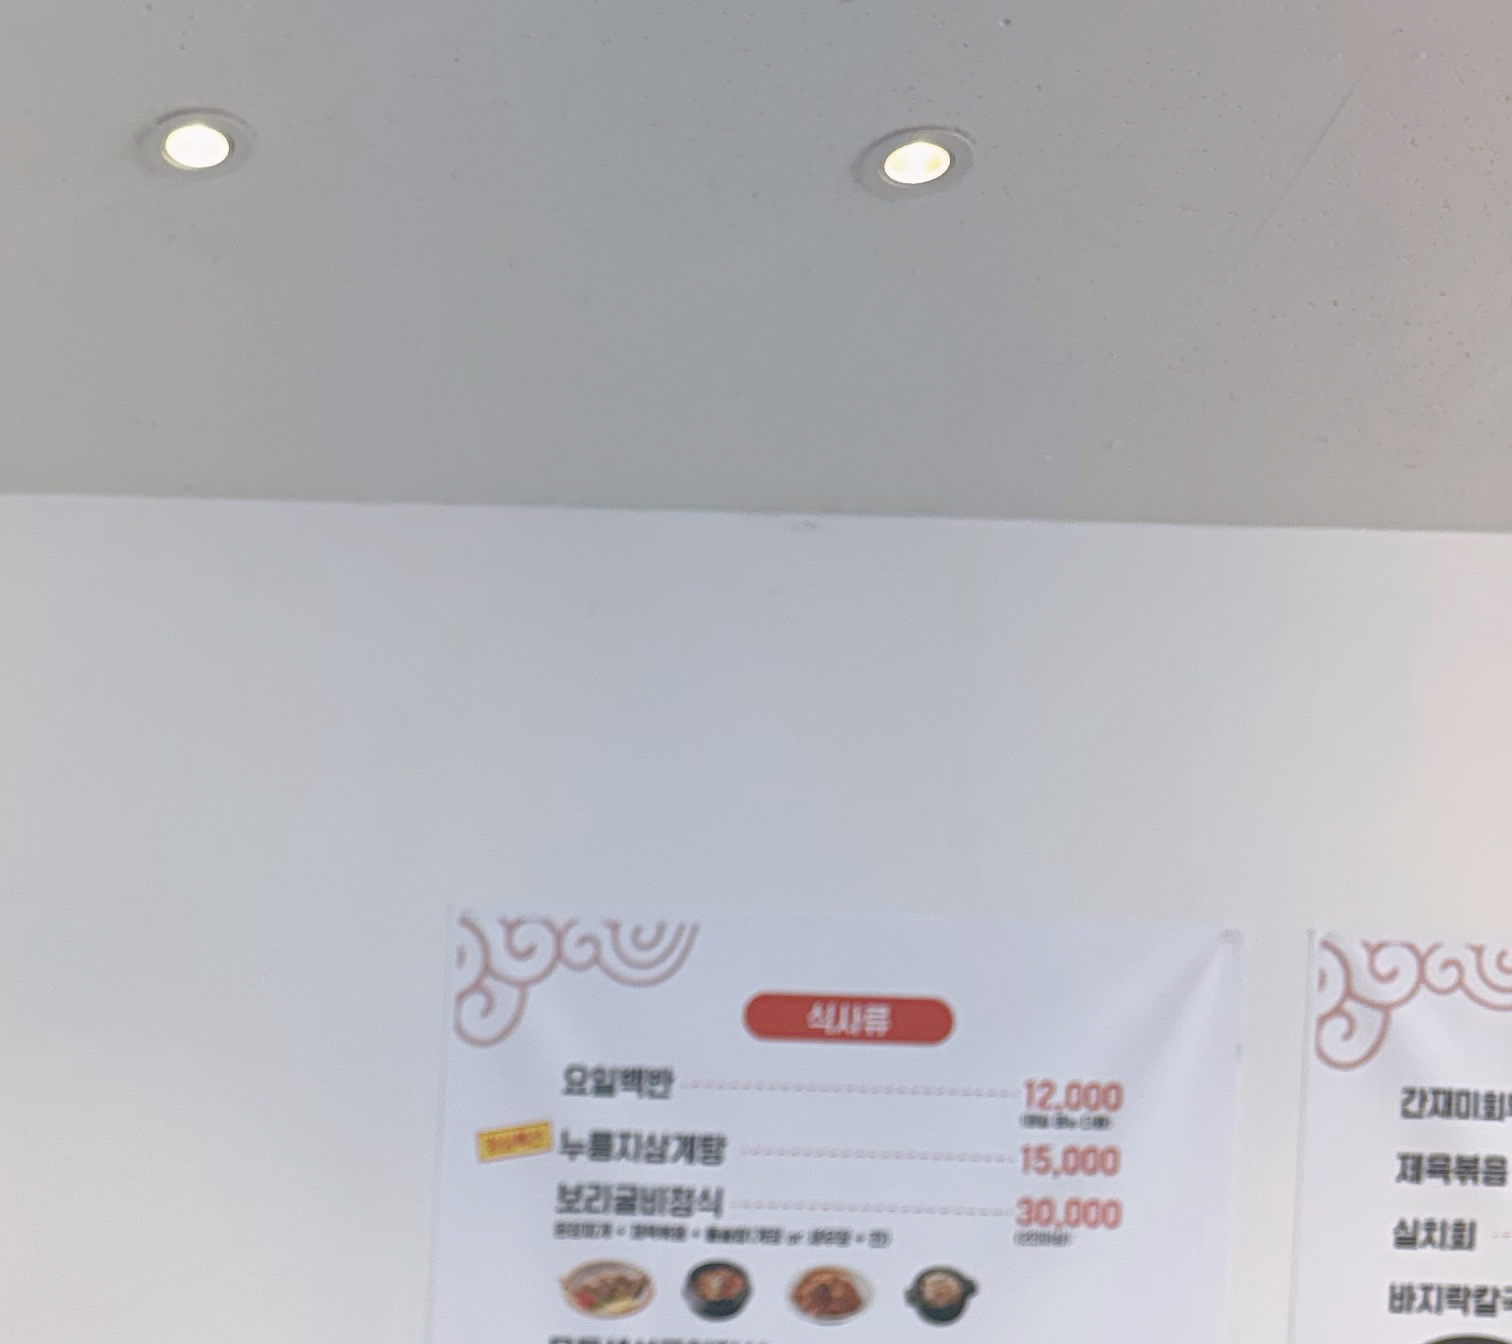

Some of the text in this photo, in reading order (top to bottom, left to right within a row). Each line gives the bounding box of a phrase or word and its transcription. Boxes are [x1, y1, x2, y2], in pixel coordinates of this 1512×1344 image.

[807, 1000, 891, 1037] 식사류
[562, 1065, 1124, 1112] 요일백반 12,000
[1400, 1087, 1512, 1122] 간재미회
[559, 1130, 727, 1166] 누룽지삼계탕
[1021, 1144, 1121, 1177] 15,000
[1395, 1153, 1509, 1187] 제육볶음
[556, 1183, 1123, 1229] 보리굴비정식 30,000
[1393, 1218, 1478, 1251] 실치회
